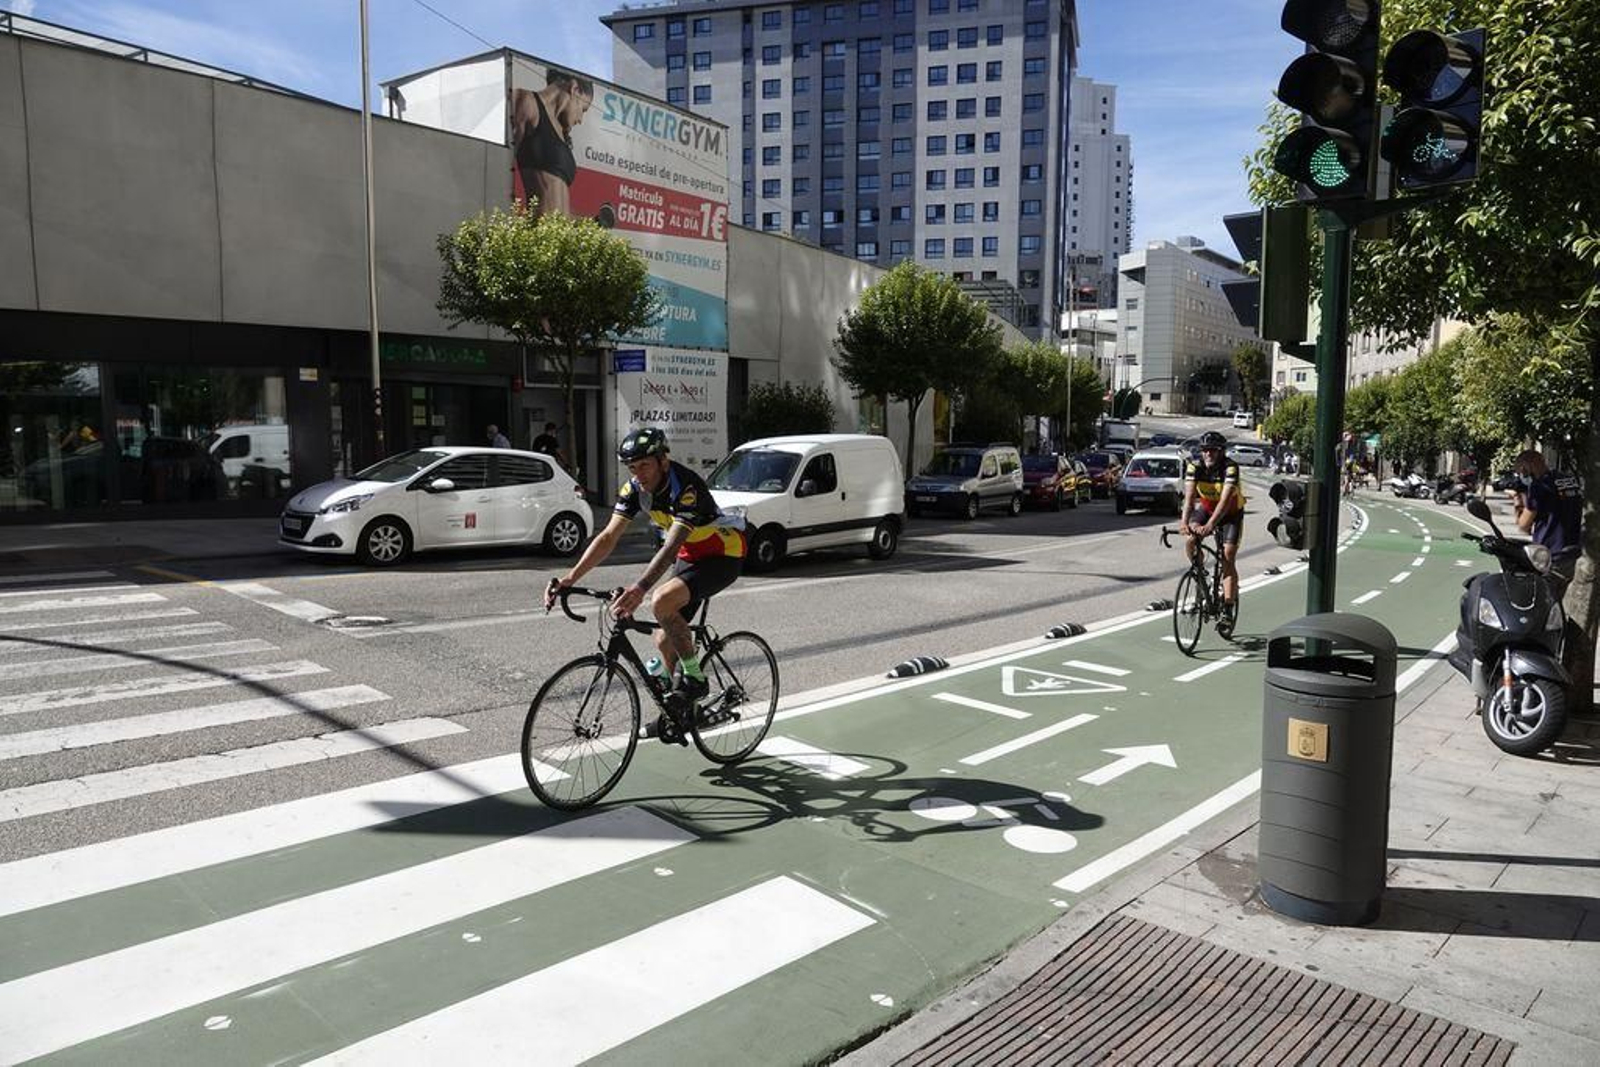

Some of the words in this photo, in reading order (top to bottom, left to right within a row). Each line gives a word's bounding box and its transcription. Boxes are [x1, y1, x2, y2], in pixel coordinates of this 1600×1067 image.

[602, 92, 721, 156] SYNERGYM
[584, 146, 615, 165] Cuota
[617, 157, 657, 176] especial
[658, 167, 671, 179] de
[672, 173, 725, 195] pre-apertura
[619, 184, 664, 206] Matrícula
[617, 202, 665, 229] GRATIS
[669, 214, 682, 227] AL
[683, 217, 699, 231] DÍA
[665, 249, 722, 271] SYNERGYM.ES
[630, 410, 670, 424] ¡PLAZAS
[672, 411, 716, 423] LIMITADAS!
